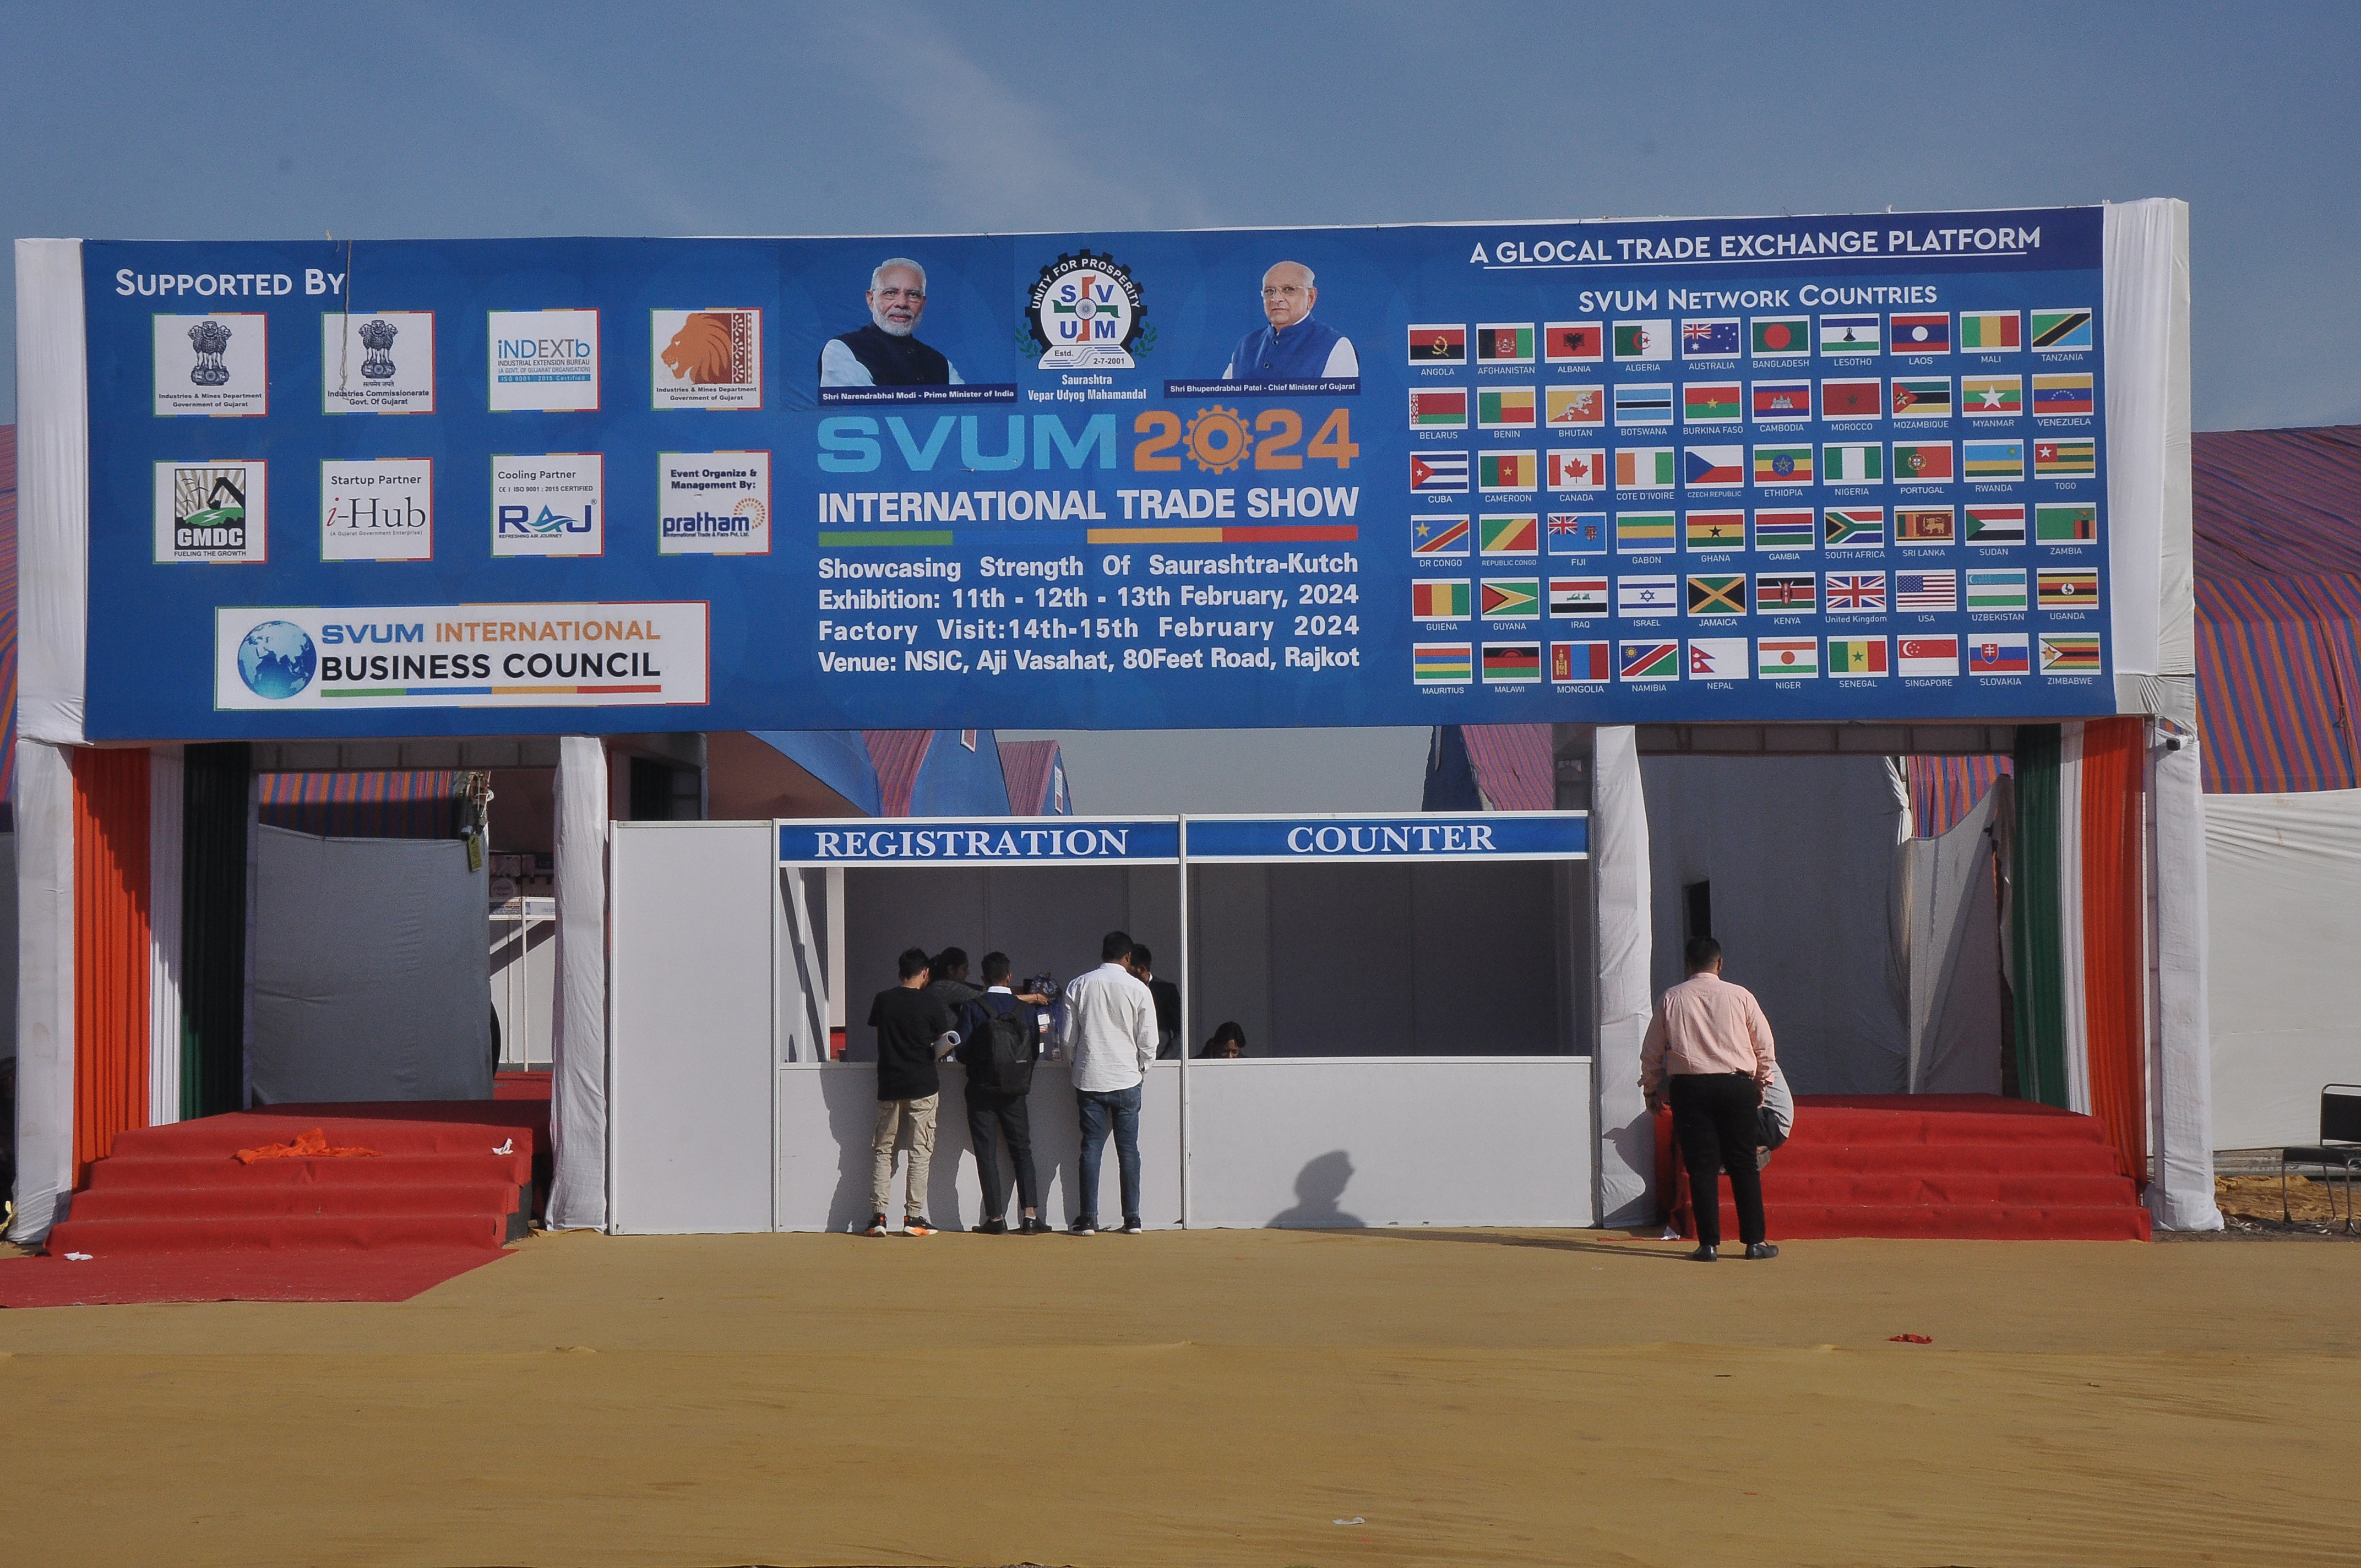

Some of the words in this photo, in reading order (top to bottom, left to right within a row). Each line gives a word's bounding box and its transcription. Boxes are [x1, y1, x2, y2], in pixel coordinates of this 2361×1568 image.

[1470, 242, 1489, 263] A
[1496, 239, 1612, 263] GLOCAL
[1617, 236, 1711, 260] TRADE
[1721, 231, 1878, 257] EXCHANGE
[1889, 226, 2040, 252] PLATFORM
[1032, 275, 1054, 309] UNITY
[1053, 259, 1078, 275] FOR
[1081, 259, 1140, 308] PROSPERITY
[1579, 289, 1657, 313] SVUM
[1689, 362, 1735, 370] AUSTRALIA
[1753, 360, 1809, 368] BANGLADESH
[1834, 358, 1872, 366] LESOTHO
[1478, 366, 1535, 374] AFGHANISTAN
[1625, 363, 1661, 372] ALGERIA
[1062, 374, 1112, 385] Saurashtra
[1187, 385, 1242, 393] Bhupendrabhai
[1328, 383, 1356, 391] Gujarat
[1027, 390, 1054, 402] Vepar
[1057, 389, 1085, 402] Udyog
[1087, 388, 1146, 400] Mahamandal
[380, 398, 408, 406] Gujarat
[1831, 423, 1873, 431] MOROCCO
[1894, 420, 1949, 428] MOZAMBIQUE
[1419, 431, 1458, 439] BELARUS
[818, 414, 1116, 473] SVUM
[498, 470, 536, 481] Cooling
[671, 469, 699, 478] Event
[702, 469, 747, 479] Organize
[331, 476, 374, 487] Startup
[379, 475, 422, 484] Partner
[671, 481, 737, 491] Management
[739, 480, 755, 491] By:
[2055, 482, 2076, 490] TOGO
[1764, 489, 1803, 497] ETHIOPIA
[1900, 486, 1944, 494] PORTUGAL
[1428, 495, 1452, 503] CUBA
[1485, 494, 1532, 503] CAMEROON
[819, 490, 1106, 522] INTERNATIONAL
[1117, 488, 1236, 519] TRADE
[1247, 487, 1359, 518] SHOW
[327, 497, 426, 528] i-Hub
[662, 511, 749, 537] pratham
[177, 528, 243, 546] GMDC
[1632, 556, 1661, 564] GABON
[819, 557, 961, 582] Showcasing
[980, 556, 1084, 581] Strength
[1102, 554, 1131, 576] Of
[1149, 552, 1358, 575] Saurashtra-Kutch
[819, 589, 940, 609] Exhibition:
[953, 587, 1005, 608] 11th
[1035, 586, 1087, 607] 12th
[1118, 586, 1170, 607] 13th
[1181, 585, 1288, 609] February,
[1299, 584, 1359, 605] 2024
[1699, 618, 1737, 627] JAMAICA
[1774, 617, 1801, 625] KENYA
[1853, 616, 1887, 624] Kingdom
[321, 623, 423, 644] SVUM
[436, 621, 661, 643] INTERNATIONAL
[819, 620, 918, 645] Factory
[1159, 616, 1274, 641] February
[1294, 615, 1359, 635] 2024
[818, 651, 896, 672] Venue:
[905, 650, 969, 674] NSIC,
[976, 650, 1007, 676] Aji
[1014, 649, 1114, 673] Vasahat,
[1123, 648, 1204, 669] 80Feet
[1211, 646, 1277, 671] Road,
[1285, 646, 1360, 672] Rajkot
[322, 654, 491, 681] BUSINESS
[503, 652, 661, 678] COUNCIL
[1707, 682, 1734, 690] NEPAL
[1775, 681, 1801, 689] NIGER
[1905, 679, 1952, 687] SINGAPORE
[1979, 678, 2022, 686] SLOVAKIA
[814, 829, 1129, 857] REGISTRATION
[1287, 825, 1497, 853] COUNTER
